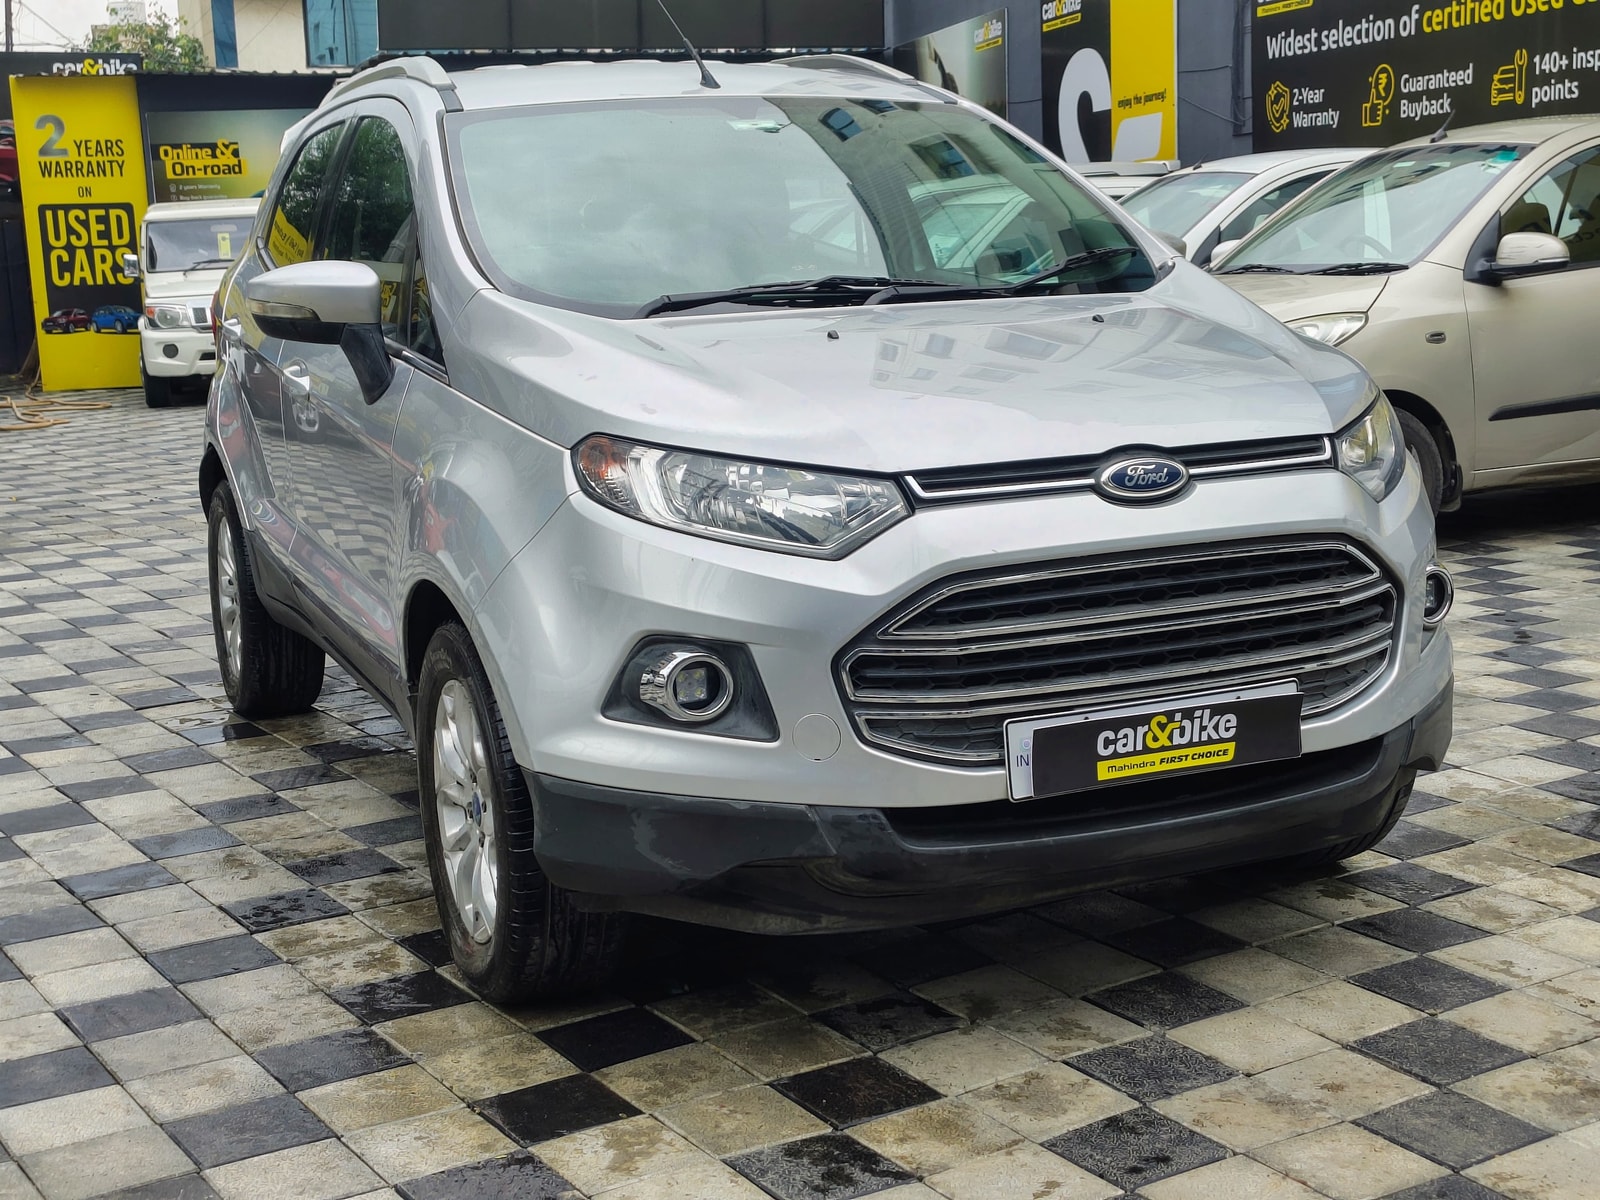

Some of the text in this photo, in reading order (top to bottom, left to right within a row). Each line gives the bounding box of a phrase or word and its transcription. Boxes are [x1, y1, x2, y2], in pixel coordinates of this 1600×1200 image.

[1266, 0, 1564, 59] Widest selection of certified Use
[1533, 51, 1569, 75] 140+
[1400, 63, 1474, 93] Guaranteed
[1133, 93, 1142, 105] the
[1292, 87, 1325, 106] 2-Year
[1531, 79, 1579, 108] points
[1400, 93, 1452, 121] Buyback
[1292, 110, 1340, 129] Warranty
[34, 114, 124, 157] 2 YEARS
[159, 138, 239, 161] Online &
[38, 160, 125, 178] WARRANTY
[172, 159, 242, 176] On-road
[77, 186, 92, 198] ON
[45, 208, 130, 248] USED
[50, 247, 135, 287] CARS
[1124, 464, 1169, 487] Ford
[1097, 709, 1237, 756] car&bike
[1016, 754, 1029, 767] IN
[1107, 748, 1230, 774] Mahindra FIRST CHOICE
